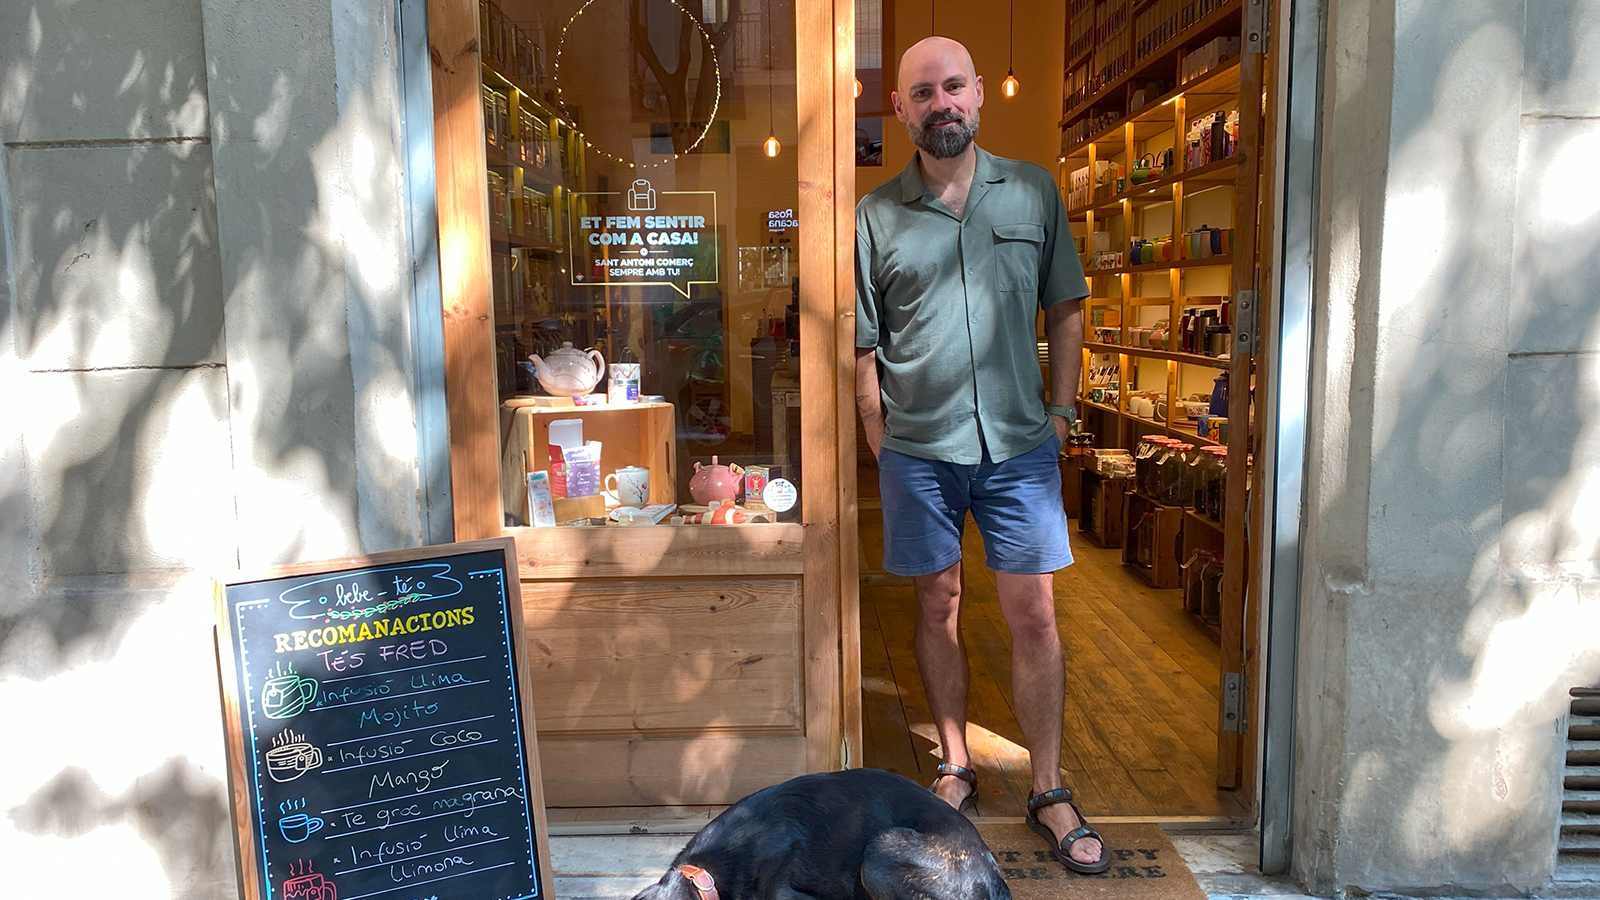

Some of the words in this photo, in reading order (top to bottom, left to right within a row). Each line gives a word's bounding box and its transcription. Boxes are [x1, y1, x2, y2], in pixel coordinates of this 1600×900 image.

[581, 216, 602, 229] ET
[606, 216, 641, 229] FEM
[644, 215, 705, 229] SENTIR
[588, 232, 627, 246] COM
[630, 232, 644, 245] A
[646, 231, 699, 246] CASA!
[595, 258, 619, 267] SANT
[620, 258, 655, 267] ANTONI
[656, 258, 694, 268] COMERÇ
[609, 268, 645, 277] SEMPRE
[645, 268, 665, 276] AMB
[666, 267, 680, 276] TU!
[335, 582, 374, 607] bebe
[273, 606, 475, 654] RECOMANACIONS
[379, 638, 448, 662] FRED
[359, 699, 439, 729] Mojito
[368, 759, 450, 798] Mango
[376, 803, 421, 830] groc
[433, 786, 525, 818] magrana
